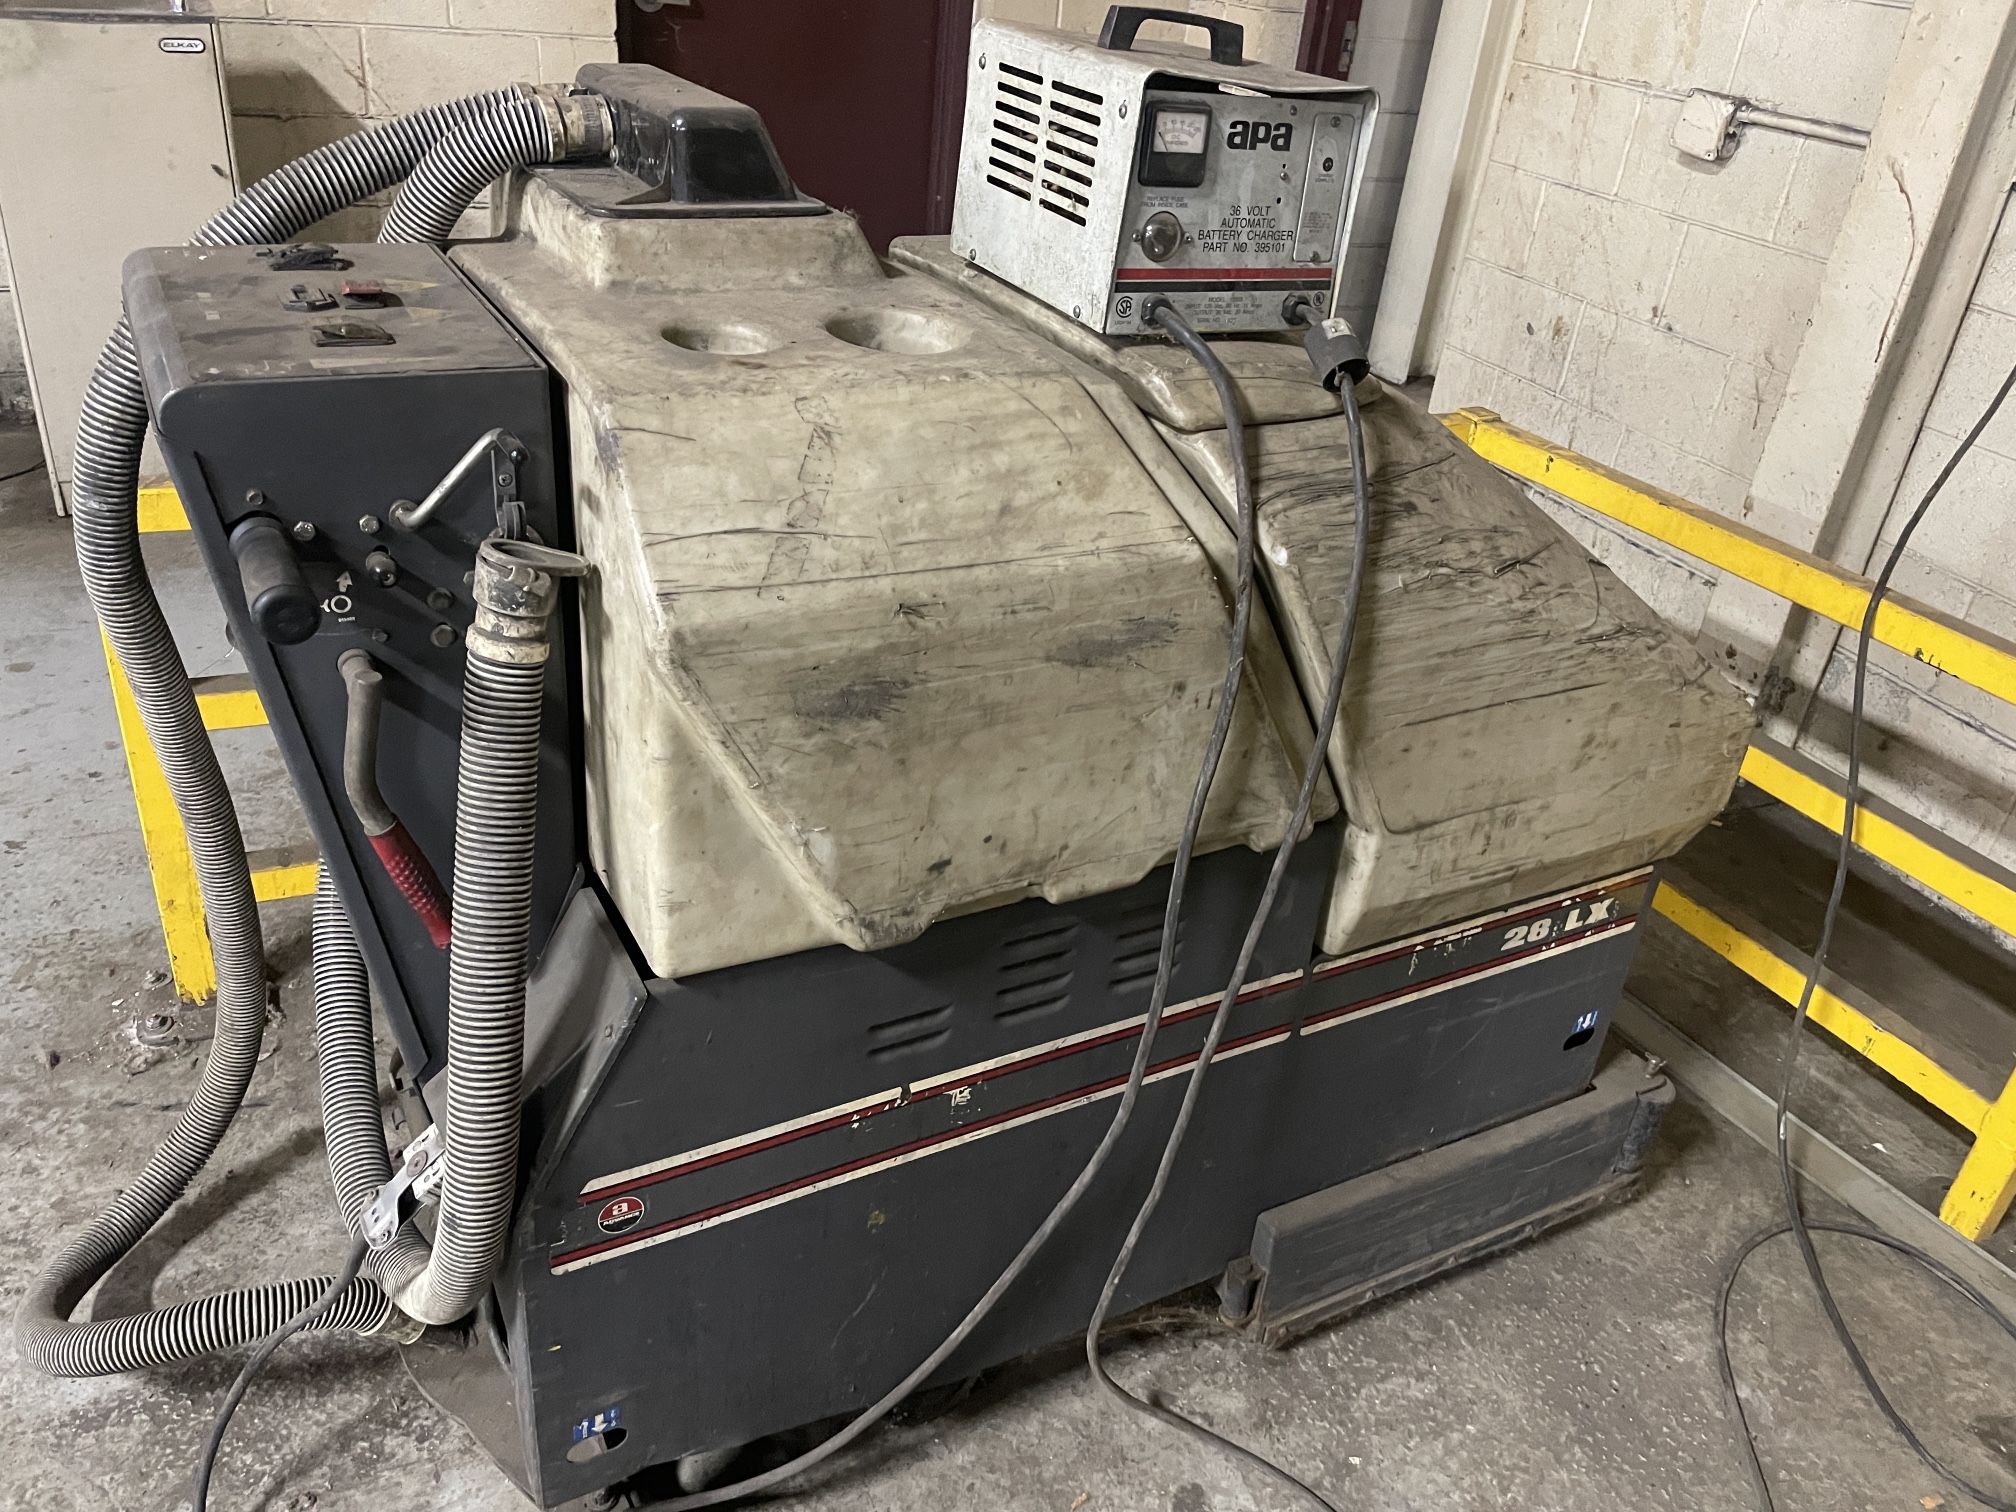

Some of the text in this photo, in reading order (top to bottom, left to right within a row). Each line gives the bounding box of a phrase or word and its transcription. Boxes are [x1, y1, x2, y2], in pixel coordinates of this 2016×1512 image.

[1227, 120, 1293, 152] apa
[1230, 205, 1272, 217] 36 VOLT
[1220, 217, 1276, 229] AUTOMATIC
[1198, 229, 1294, 241] BATTERY CHARGER
[1202, 241, 1228, 253] PART
[1254, 242, 1285, 253] 395101
[1500, 898, 1614, 951] 28 LX
